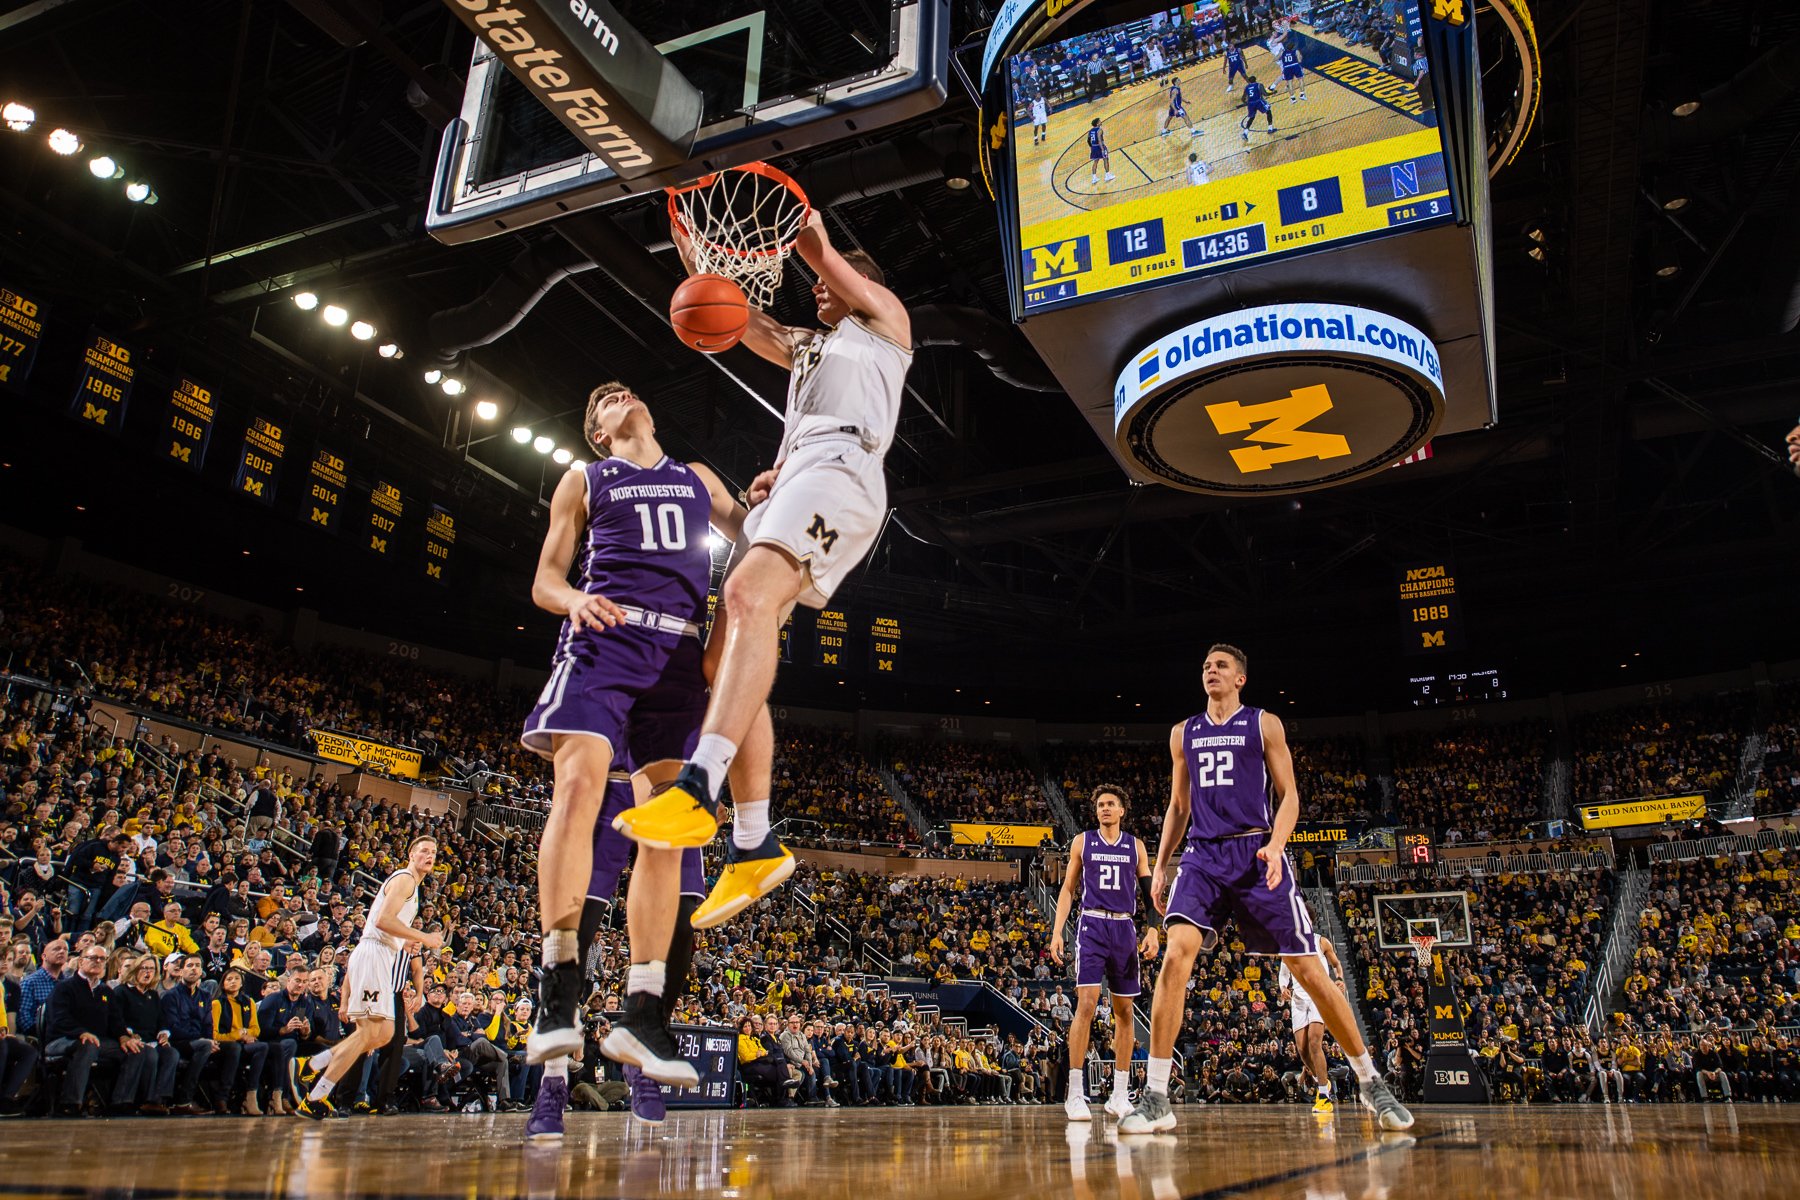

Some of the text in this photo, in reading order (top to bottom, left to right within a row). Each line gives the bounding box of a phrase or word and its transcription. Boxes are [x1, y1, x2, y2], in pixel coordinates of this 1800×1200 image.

[1390, 161, 1420, 199] N
[1302, 187, 1318, 212] 8
[1195, 205, 1233, 223] HALF 1
[1395, 201, 1440, 220] TOL 3
[1123, 227, 1148, 253] 12
[1275, 224, 1325, 244] FOULS 01
[1197, 232, 1250, 260] 14:36
[1031, 240, 1079, 281] M
[1130, 259, 1176, 277] 01 FOULS
[1028, 284, 1066, 302] TOL 4
[84, 357, 131, 383] MEN'S BASKETBALL
[86, 348, 134, 377] CHAMPIONS
[86, 376, 122, 402] 1985
[171, 398, 211, 423] MEN'S BASKETBALL
[173, 390, 214, 417] CHAMPIONS
[83, 402, 108, 425] M
[172, 415, 202, 440] 1986
[1204, 383, 1352, 474] M
[247, 427, 285, 452] CHAMPIONS
[170, 441, 191, 463] M
[257, 441, 283, 458] BASKETBALL
[245, 452, 273, 475] 2012
[312, 461, 347, 483] CHAMPIONS
[243, 476, 264, 497] M
[322, 473, 346, 489] BASKETBALL
[312, 484, 338, 506] 2014
[609, 485, 696, 502] NORTHWESTERN
[311, 506, 329, 526] M
[371, 513, 395, 533] 2017
[634, 503, 687, 551] 10
[806, 513, 839, 555] M
[370, 535, 387, 554] M
[427, 541, 449, 559] 2018
[426, 562, 442, 579] M
[1406, 566, 1446, 581] NCAA
[168, 583, 206, 604] 207
[1400, 577, 1455, 593] CHAMPIONS
[1401, 588, 1456, 600] MEN'S BASKETBALL
[646, 613, 656, 626] N
[821, 611, 844, 620] NCAA
[876, 618, 898, 627] NCAA
[1412, 605, 1449, 622] 1989
[888, 627, 901, 635] FOUR
[1422, 630, 1446, 648] M
[388, 642, 420, 659] 208
[821, 636, 842, 647] 2013
[875, 643, 896, 653] 2018
[823, 653, 838, 665] M
[878, 660, 893, 671] M
[1422, 685, 1430, 694] 12
[1492, 678, 1499, 687] 8
[1645, 684, 1673, 698] 215
[772, 708, 788, 720] 10
[1452, 708, 1477, 720] 214
[1103, 726, 1127, 738] 212
[1191, 735, 1246, 749] NORTHWESTERN
[318, 743, 397, 768] CREDIT UNION
[360, 743, 374, 751] OF
[375, 747, 420, 765] MICHIGAN
[1198, 750, 1234, 788] 22
[1601, 808, 1620, 817] OLD
[1622, 803, 1670, 815] NATIONAL
[1670, 800, 1697, 809] BANK
[1287, 829, 1348, 842] rislerLIVE
[1405, 834, 1430, 845] 14:36
[1413, 845, 1429, 863] 19
[1099, 864, 1121, 891] 21
[362, 990, 380, 1002] M
[915, 992, 939, 1000] TUNNEL
[1434, 1005, 1454, 1019] M
[706, 1037, 732, 1052] NWESTERN
[1439, 1032, 1464, 1040] UMCU
[717, 1056, 725, 1072] 8
[721, 1082, 727, 1098] 3
